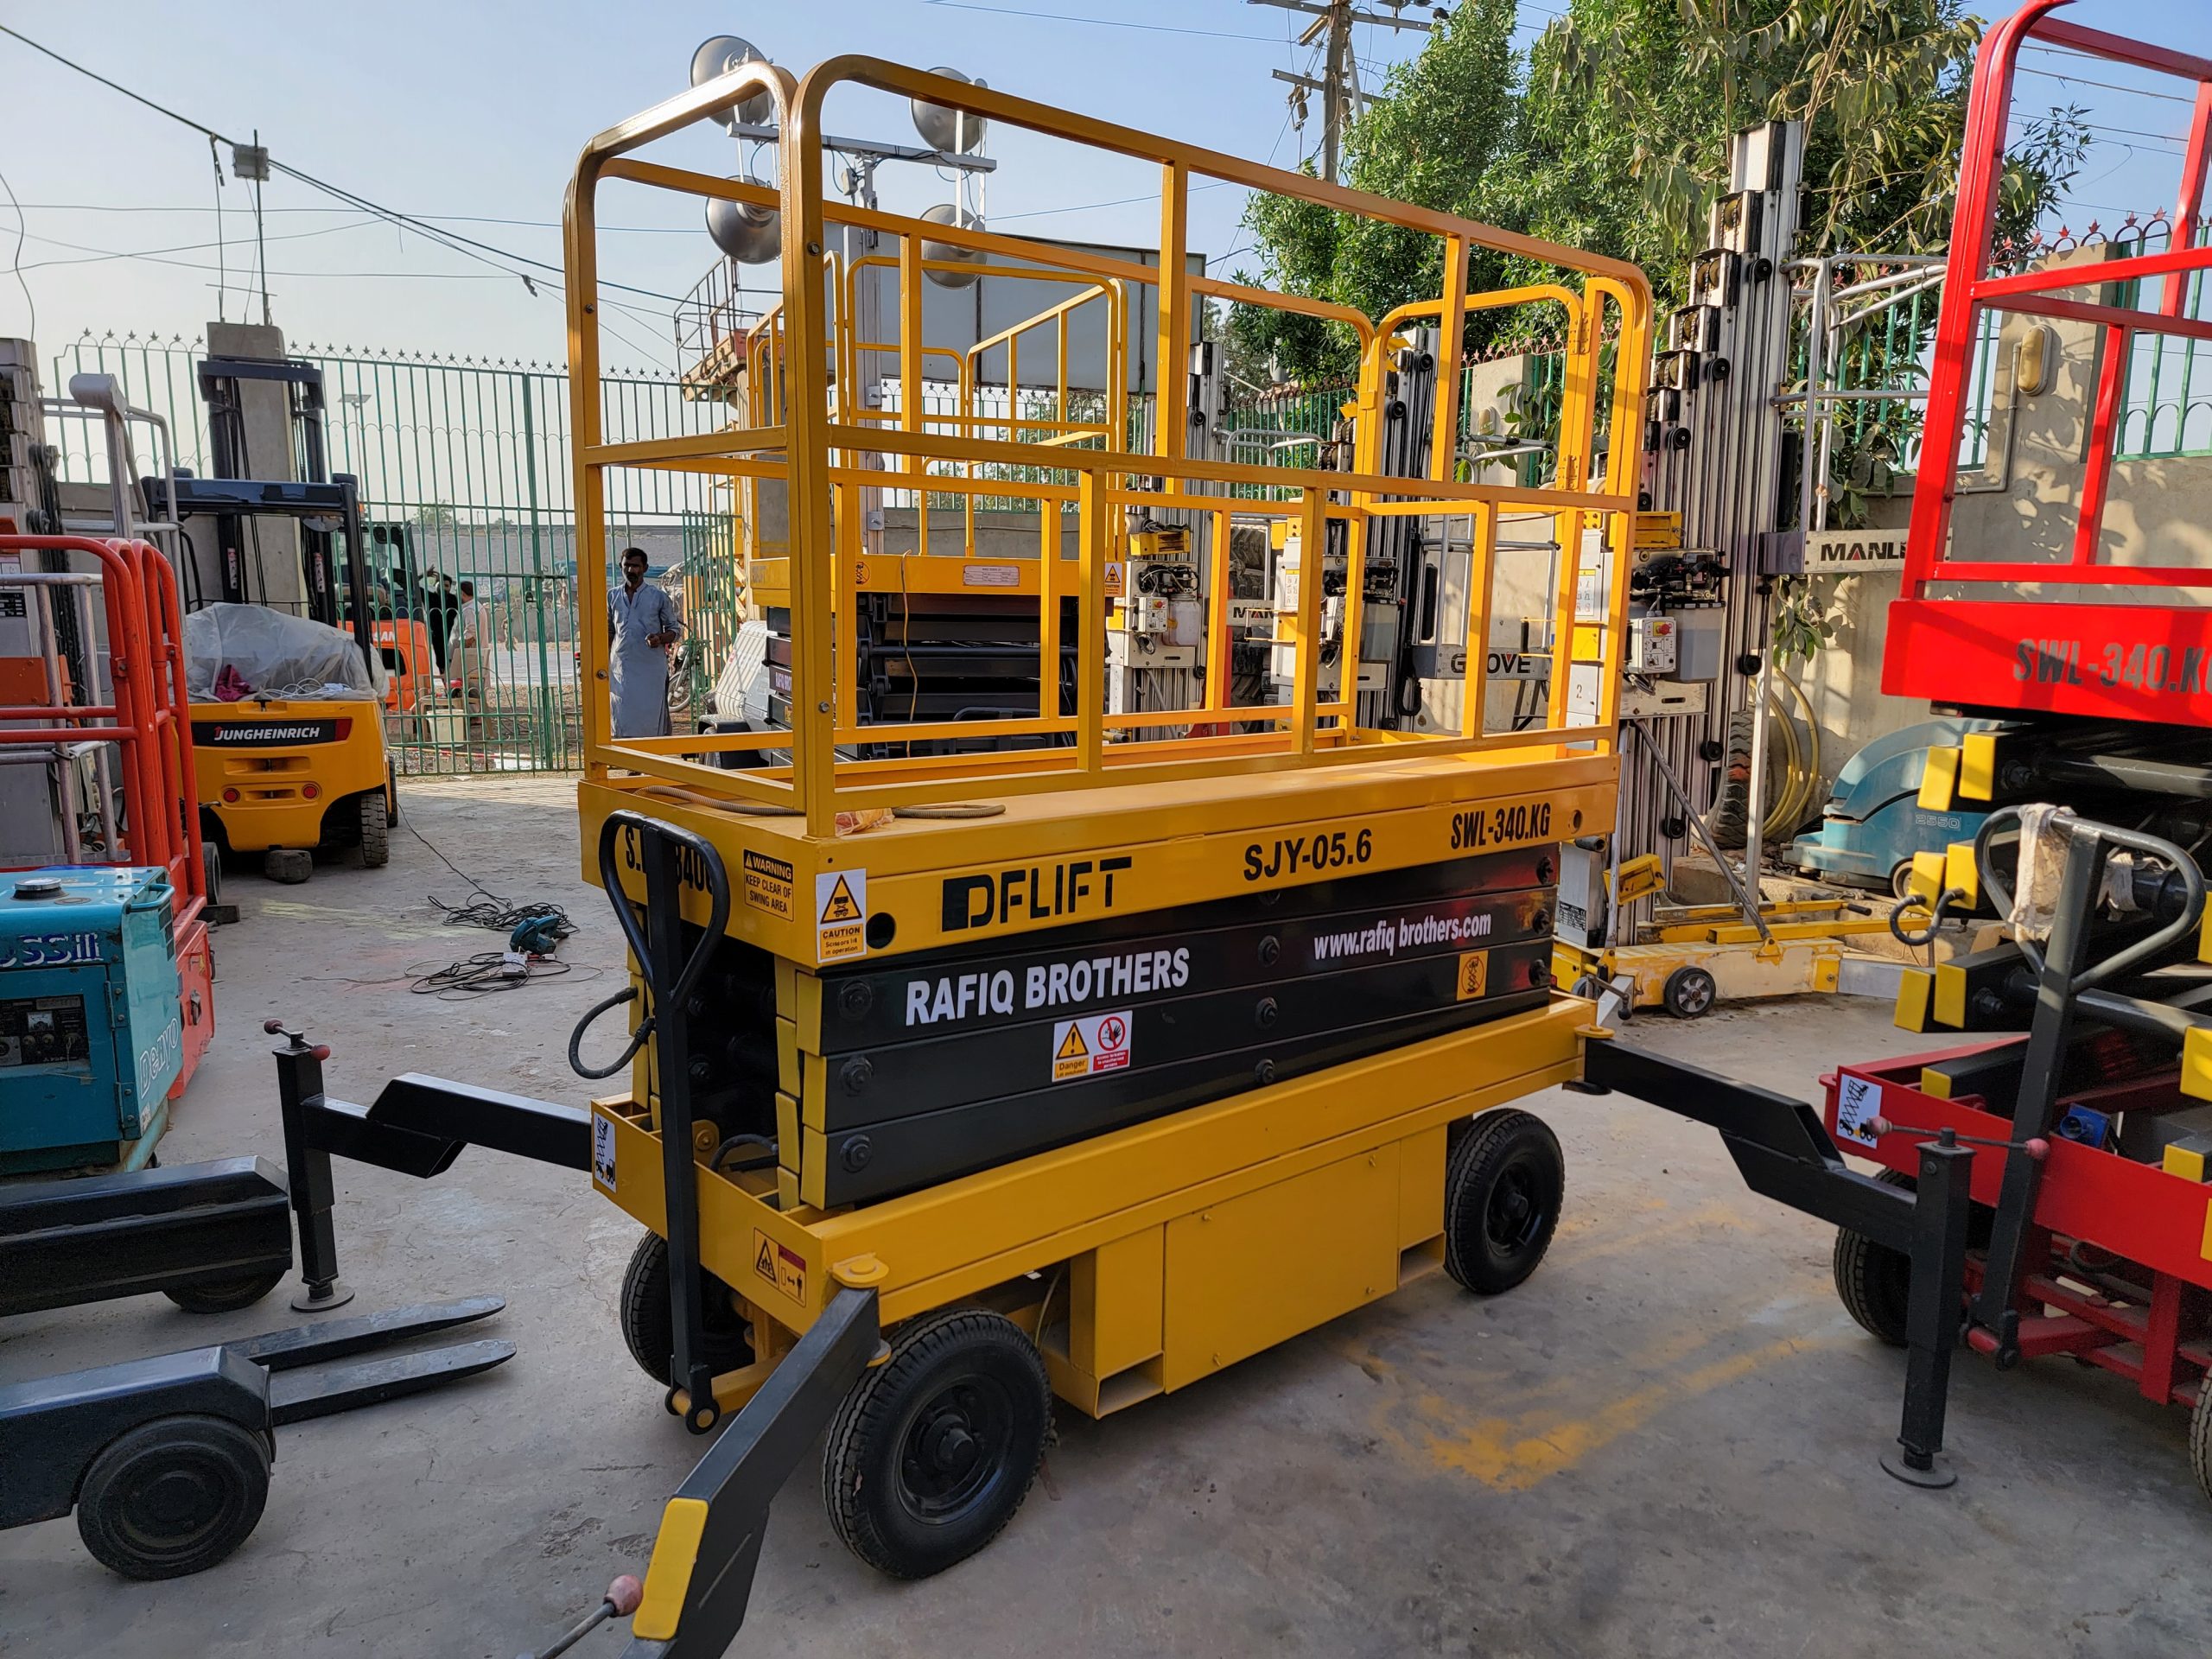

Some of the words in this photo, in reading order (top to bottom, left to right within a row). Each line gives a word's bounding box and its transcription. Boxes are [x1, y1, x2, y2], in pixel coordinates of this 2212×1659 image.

[1450, 652, 1531, 674] GOVE
[2013, 639, 2212, 695] SWL-340.K
[214, 726, 320, 741] JUNGHEINRICH
[1451, 802, 1552, 850] SWL-340.KG
[1915, 814, 1961, 830] 2550
[753, 855, 792, 880] WARNING
[1243, 829, 1373, 881] SJY-05.6
[745, 872, 761, 887] KEEP
[762, 878, 781, 895] CLEAR
[783, 886, 791, 899] OF
[942, 856, 1132, 932] DFLIFT
[749, 890, 770, 907] SWING
[771, 897, 788, 913] AREA
[823, 926, 861, 939] CAUTION
[1313, 920, 1395, 961] www.rafiq
[1398, 913, 1491, 949] brothers.com
[906, 969, 1014, 1027] RAFIQ
[1025, 947, 1190, 1009] BROTHERS
[1059, 1059, 1085, 1071] Danger
